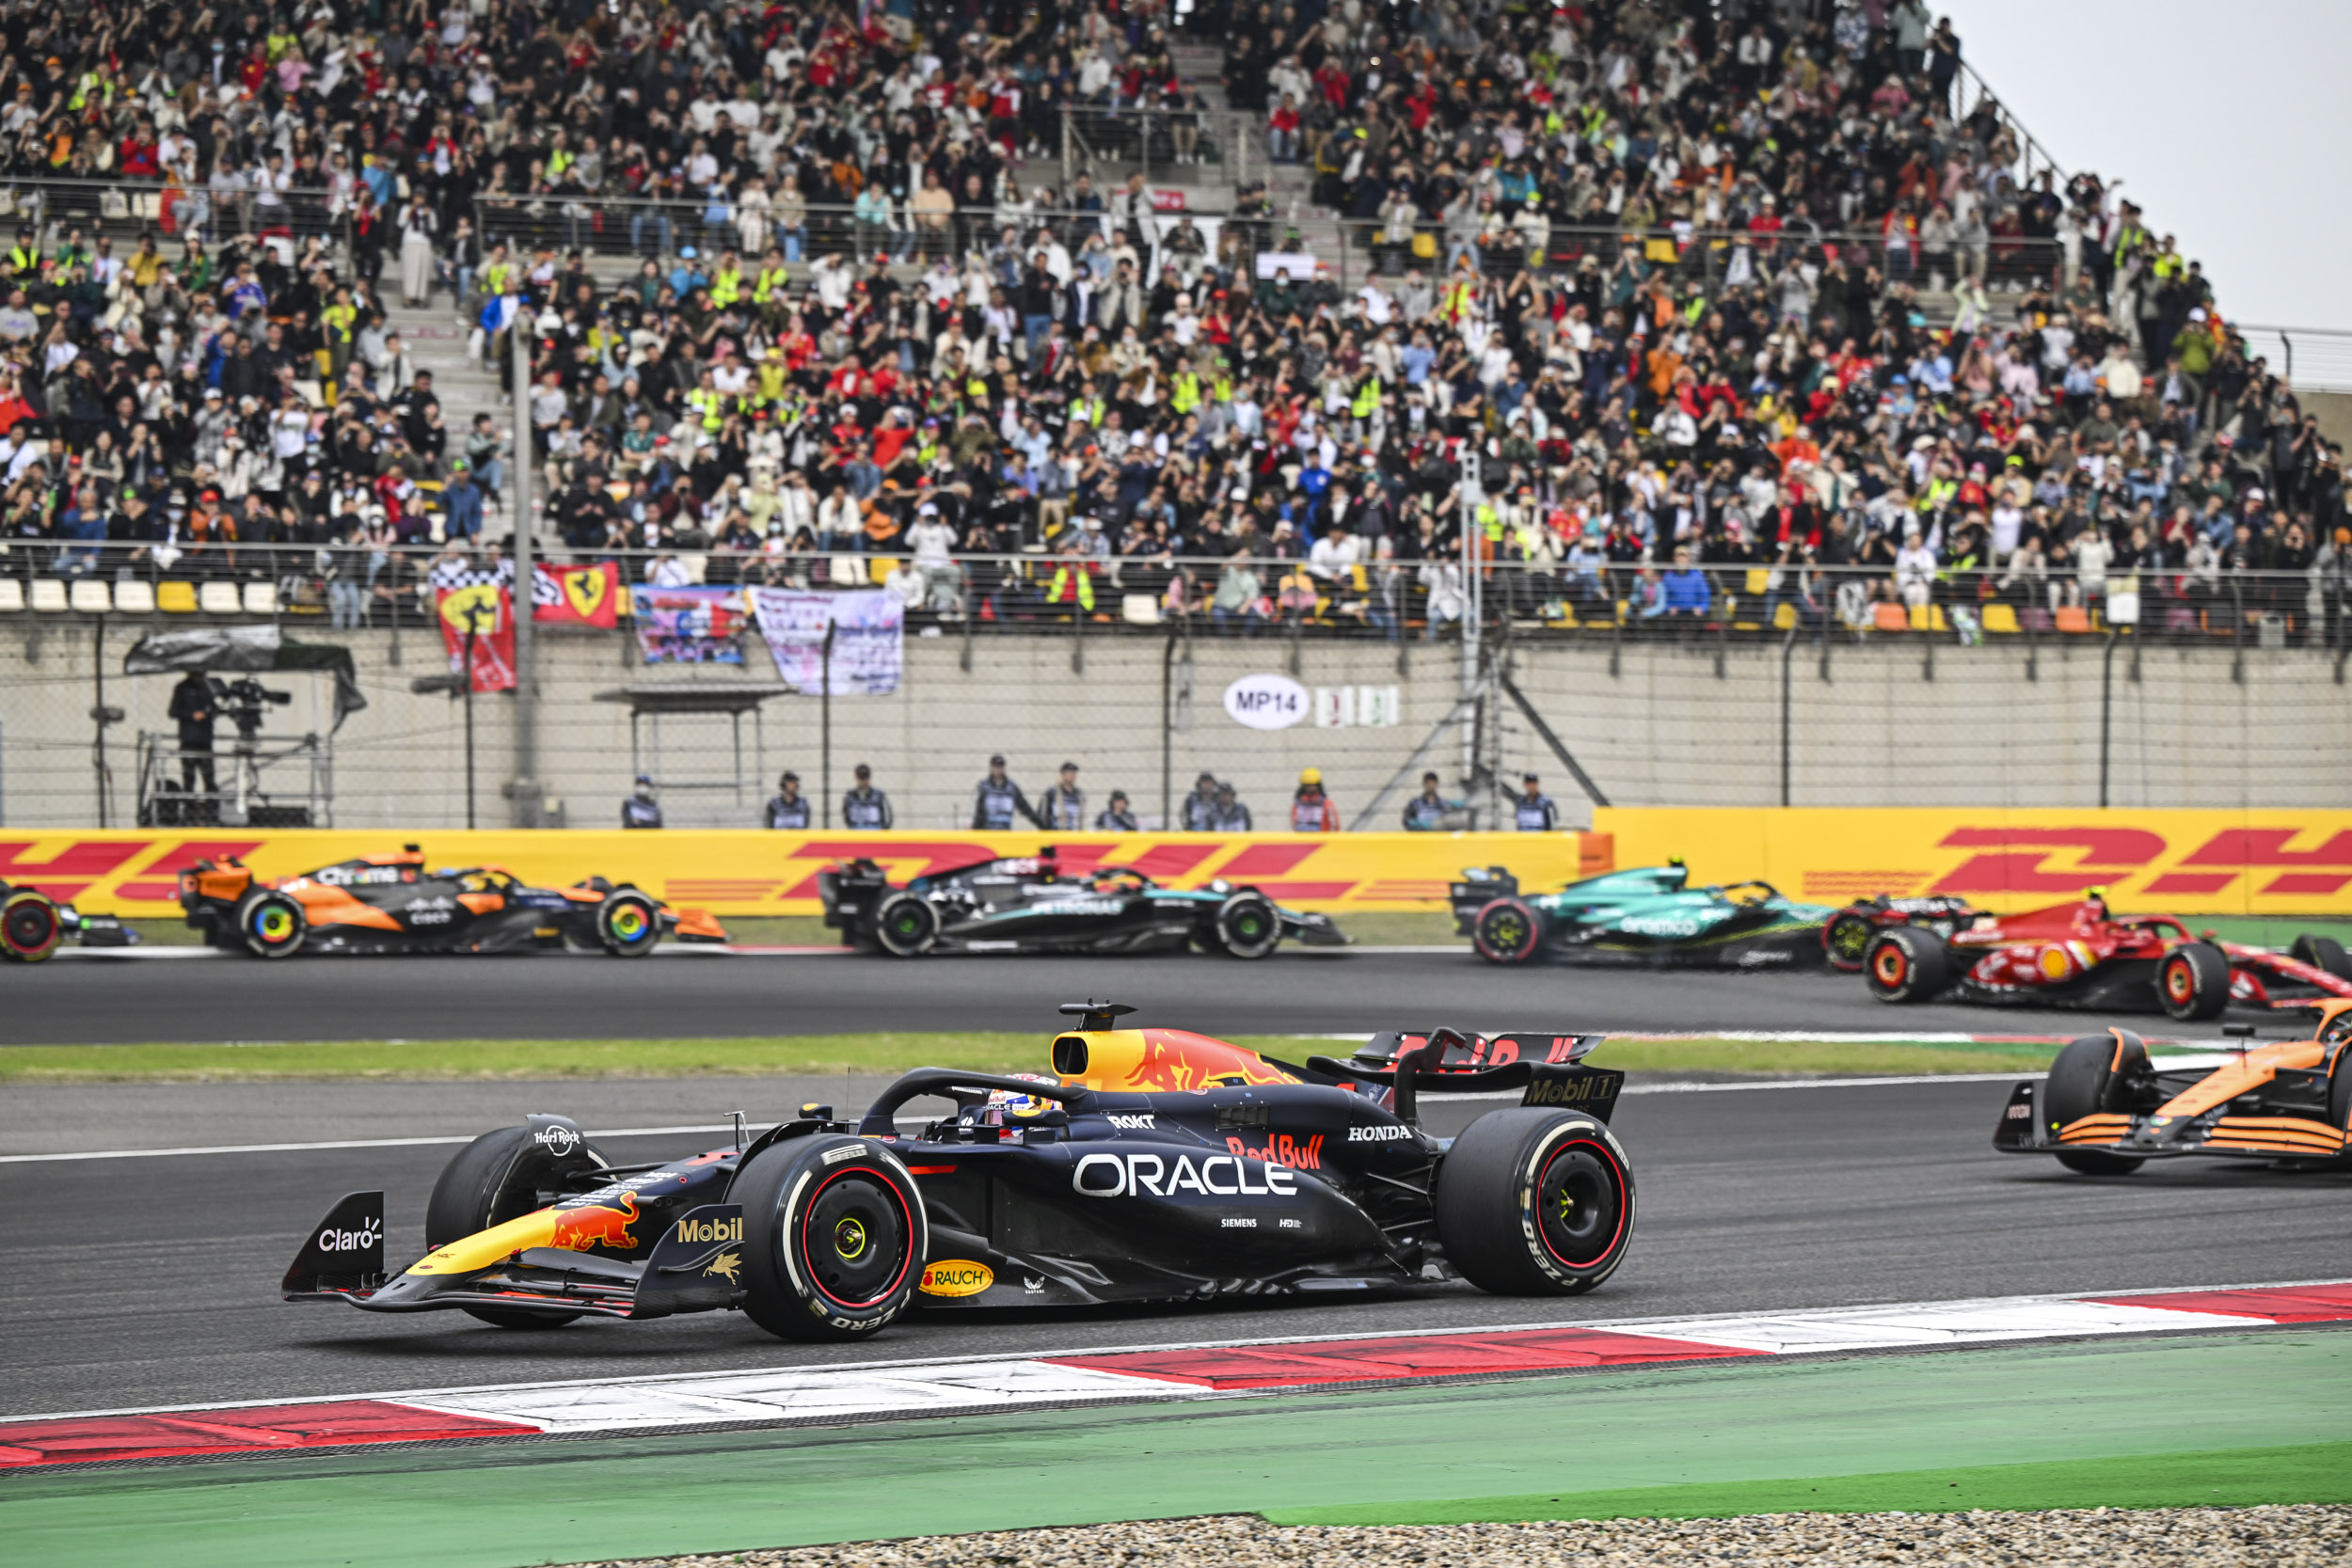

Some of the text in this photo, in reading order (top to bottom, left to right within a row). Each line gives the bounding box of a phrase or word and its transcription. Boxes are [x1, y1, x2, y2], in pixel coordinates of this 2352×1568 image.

[1235, 691, 1298, 714] MP14
[0, 842, 275, 900] HL
[1926, 828, 2352, 893] DH
[1526, 1076, 1594, 1104] Mobil
[1107, 1115, 1156, 1130] ROKT
[1348, 1126, 1413, 1141] HONDA
[534, 1131, 580, 1145] Hard Rock
[1226, 1133, 1325, 1170] Red Bull
[1073, 1153, 1298, 1197] ORACLE
[677, 1217, 743, 1243] Mobil
[1221, 1218, 1257, 1227] SIEMENS
[319, 1227, 373, 1252] Claro
[1522, 1219, 1563, 1280] ZERO
[935, 1270, 984, 1286] RAUCH
[830, 1306, 898, 1331] ZERO
